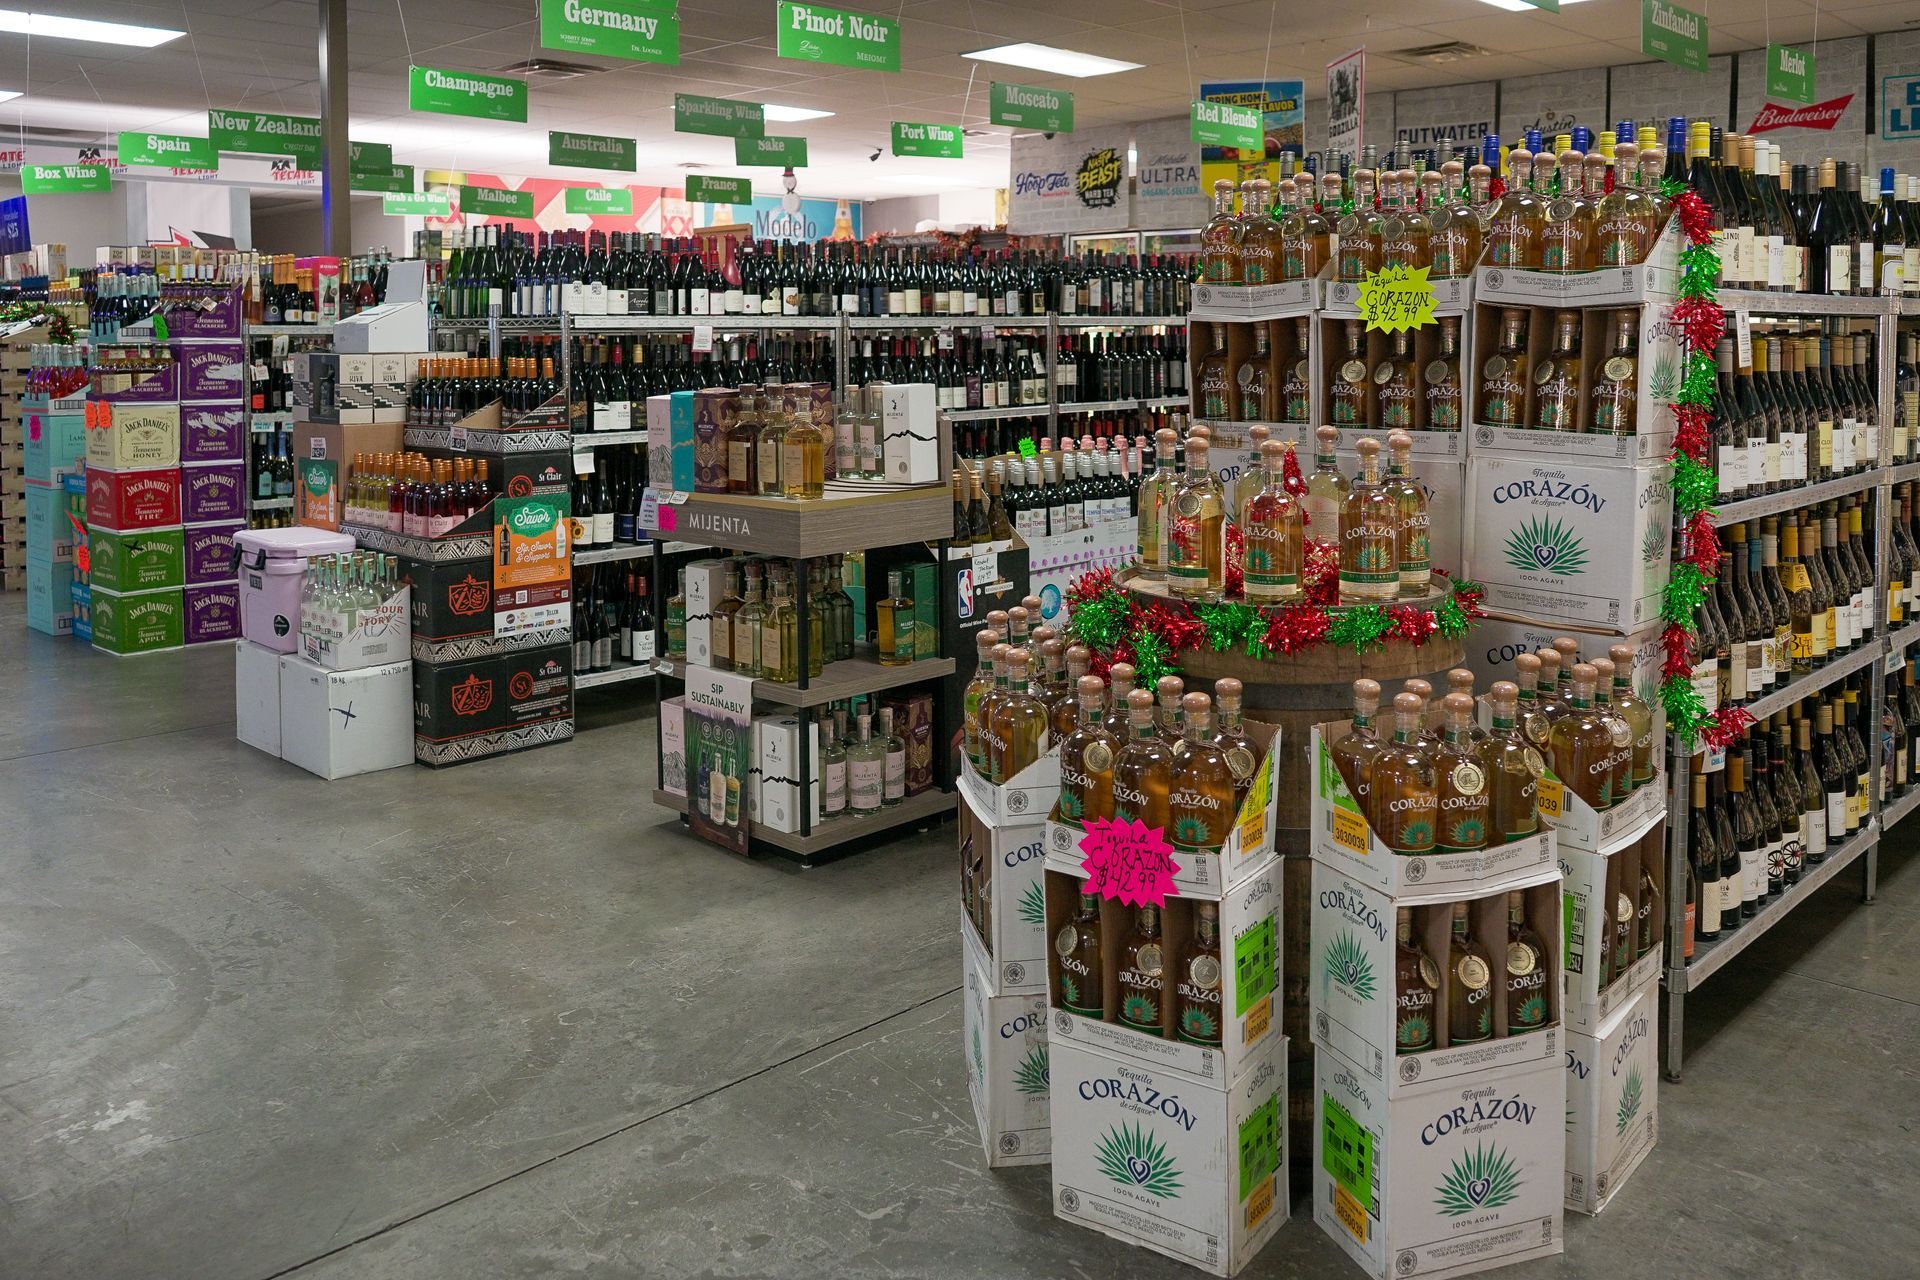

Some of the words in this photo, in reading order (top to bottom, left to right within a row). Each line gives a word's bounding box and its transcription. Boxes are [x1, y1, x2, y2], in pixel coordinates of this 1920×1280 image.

[564, 0, 658, 40] Germany
[791, 6, 844, 36] Pinot
[848, 16, 888, 43] Noir
[1651, 0, 1699, 40] Zinfandel
[1780, 49, 1806, 77] Merlot
[425, 70, 514, 98] Champagne
[1005, 85, 1060, 110] Moscato
[1240, 93, 1267, 104] HOME
[678, 98, 732, 121] Sparkling
[735, 105, 762, 121] Wine
[1197, 102, 1220, 124] Red
[1221, 106, 1257, 129] Blends
[1754, 106, 1845, 129] Budweiser
[210, 110, 250, 131] New
[1523, 114, 1576, 134] Austin
[900, 124, 925, 140] Port
[927, 126, 954, 142] Wine
[1398, 122, 1488, 145] CUTWATER
[147, 135, 191, 154] Spain
[561, 133, 624, 154] Australia
[758, 139, 785, 152] Sake
[1087, 149, 1114, 171] NASTY
[34, 167, 61, 179] Box
[64, 166, 97, 179] Wine
[272, 170, 315, 182] TECATE
[1078, 162, 1122, 193] BEAST
[1141, 166, 1198, 184] ULTRA
[702, 176, 738, 191] France
[1016, 172, 1045, 196] Hoop
[1045, 171, 1070, 189] Tea
[385, 192, 406, 202] Grab
[414, 192, 426, 202] Go
[427, 193, 446, 203] Wine
[477, 188, 518, 204] Malbec
[585, 189, 612, 203] Chile
[756, 209, 817, 240] Modelo
[1597, 221, 1648, 236] CORAZÓN
[1366, 290, 1430, 307] CORAZON
[190, 354, 208, 368] JACK
[125, 419, 142, 434] JACK
[142, 417, 170, 433] DANIEL'S
[192, 476, 210, 490] JACK
[209, 473, 236, 487] DANIEL'S
[546, 472, 562, 481] Clair
[1532, 468, 1566, 480] Tequila
[126, 481, 143, 497] JACK
[143, 479, 171, 494] DANIEL'S
[1493, 480, 1607, 514] CORAZÓN
[198, 505, 231, 513] BLACKBERRY
[514, 507, 551, 526] Savor
[689, 512, 751, 536] MIJENTA
[1346, 525, 1397, 540] CORAZÓN
[148, 541, 175, 556] DANIEL'S
[194, 537, 211, 551] JACK
[1519, 574, 1538, 583] 100%
[1540, 577, 1565, 586] AGAVE
[129, 605, 147, 620] JACK
[147, 602, 174, 617] DANIEL'S
[193, 597, 210, 612] JACK
[210, 593, 236, 607] DANIEL'S
[376, 606, 404, 614] YOUR
[412, 601, 429, 618] AIR
[200, 625, 232, 633] BLACKBERRY
[359, 615, 393, 627] STORY
[138, 636, 167, 644] APPLE
[546, 665, 563, 675] Clair
[711, 682, 724, 695] SIP
[415, 702, 432, 720] AIR
[691, 691, 745, 715] SUSTAINABLY
[1169, 792, 1221, 811] CORAZÓN
[1335, 827, 1365, 850] 3030039
[1090, 846, 1172, 873] CORAZON
[1319, 891, 1388, 943] CORAZÓN
[1612, 1013, 1649, 1077] CORAZÓN
[1117, 1066, 1153, 1086] Tequila
[1333, 1073, 1372, 1111] CORAZÓN
[1461, 1086, 1496, 1101] Tequila
[1078, 1078, 1198, 1132] CORAZÓN
[1420, 1094, 1537, 1146] CORAZÓN
[1112, 1187, 1134, 1199] 100%
[1135, 1194, 1161, 1208] AGAVE
[1452, 1218, 1473, 1230] 100%
[1474, 1213, 1499, 1226] AGAVE
